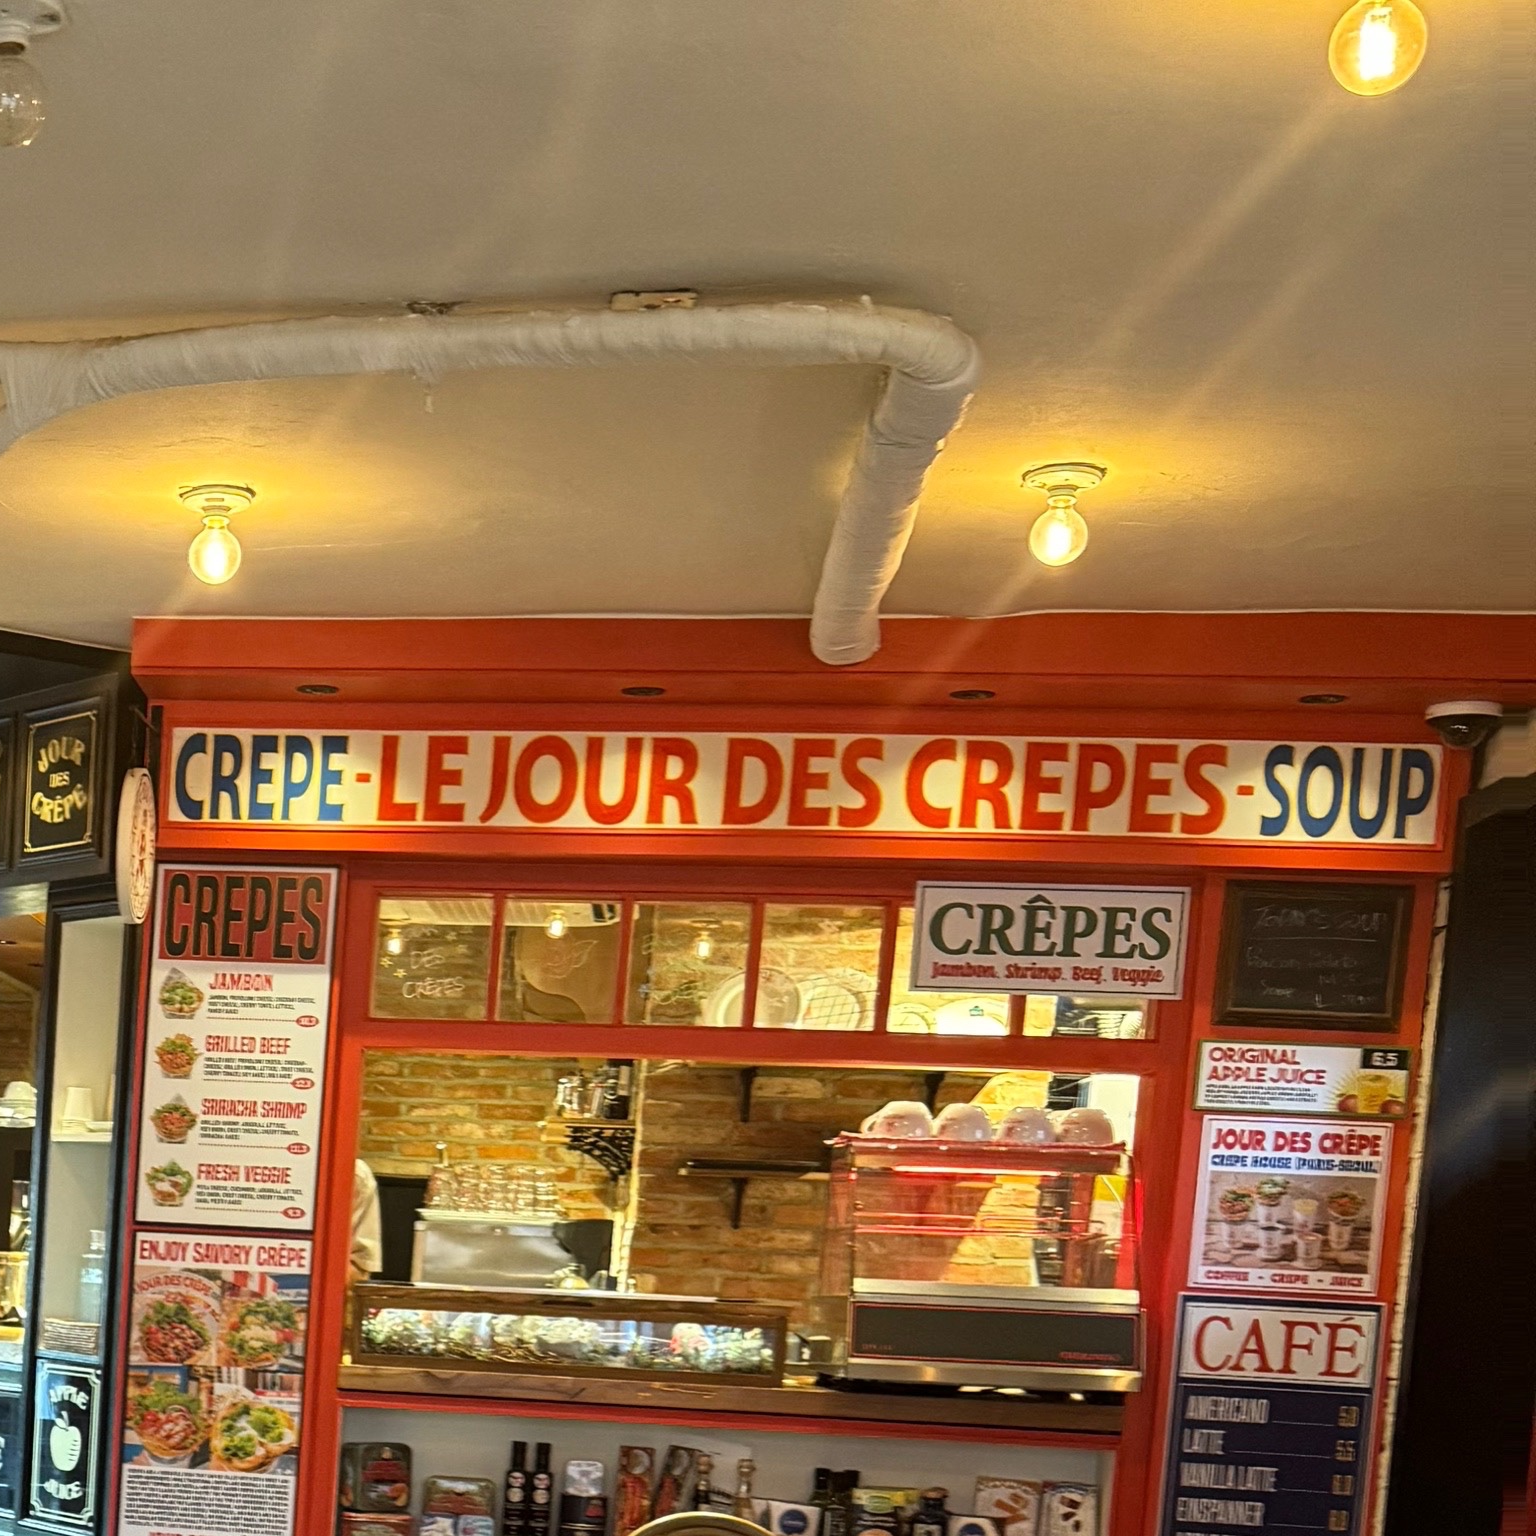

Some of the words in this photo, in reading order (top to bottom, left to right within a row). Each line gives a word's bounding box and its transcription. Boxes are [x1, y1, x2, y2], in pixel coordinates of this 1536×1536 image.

[37, 736, 86, 773] JOUR
[49, 771, 70, 788] DES
[478, 735, 699, 826] JOUR
[721, 738, 885, 829] DES
[31, 783, 88, 823] CRÊPE
[166, 873, 323, 961] CREPES
[929, 893, 1172, 960] CRÊPES
[209, 973, 273, 992] JAMBON
[206, 1035, 256, 1053] GRILLED
[260, 1037, 291, 1054] BEEF
[1209, 1047, 1300, 1065] ORIGINAL
[1207, 1066, 1266, 1083] APPLE
[1270, 1068, 1327, 1085] JUICE
[261, 1100, 308, 1119] SHRIMP
[1212, 1128, 1266, 1151] JOUR
[1273, 1131, 1312, 1153] DES
[1319, 1129, 1382, 1157] CRÊPE
[197, 1164, 240, 1181] FRESH
[244, 1165, 292, 1184] VEGGIE
[139, 1240, 189, 1262] ENJOY
[193, 1242, 253, 1265] SAVORY
[256, 1243, 307, 1268] CRÊPE
[1194, 1316, 1366, 1378] CAFÉ
